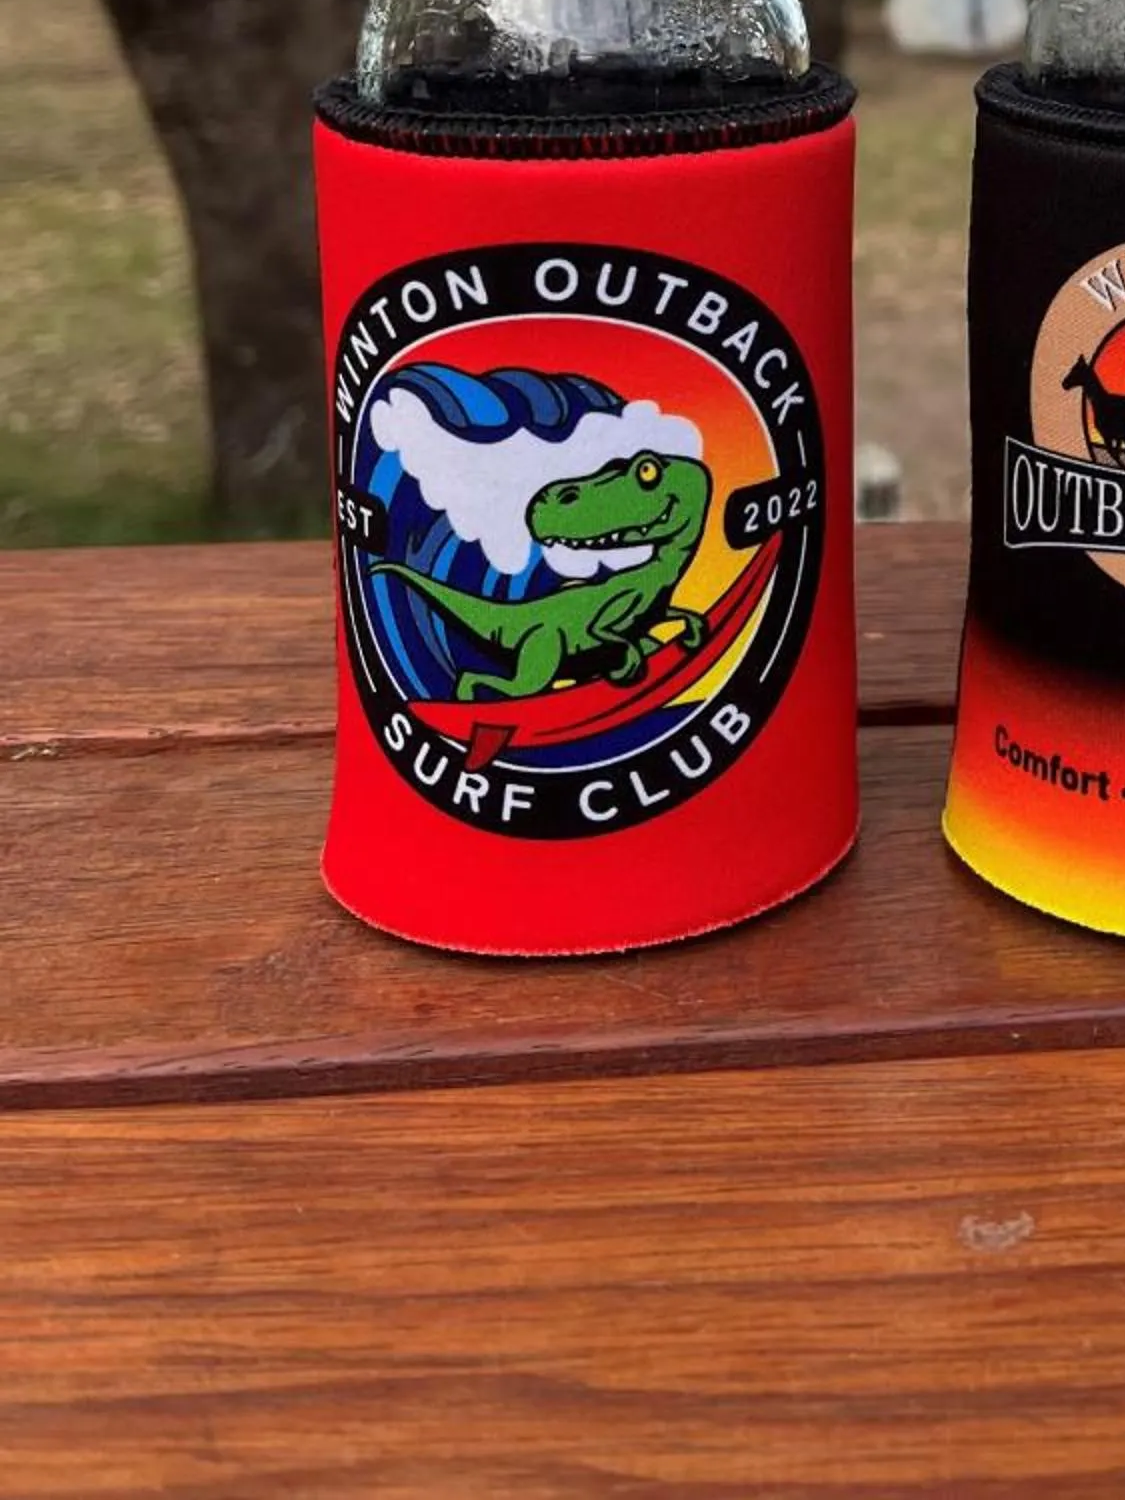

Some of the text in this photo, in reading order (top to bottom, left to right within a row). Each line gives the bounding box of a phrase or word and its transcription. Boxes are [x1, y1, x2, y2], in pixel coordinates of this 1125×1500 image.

[335, 258, 805, 427] WINTON OUTBACK
[743, 481, 818, 531] 2022
[382, 703, 752, 822] SURF CLUB
[994, 724, 1111, 801] Comfort
